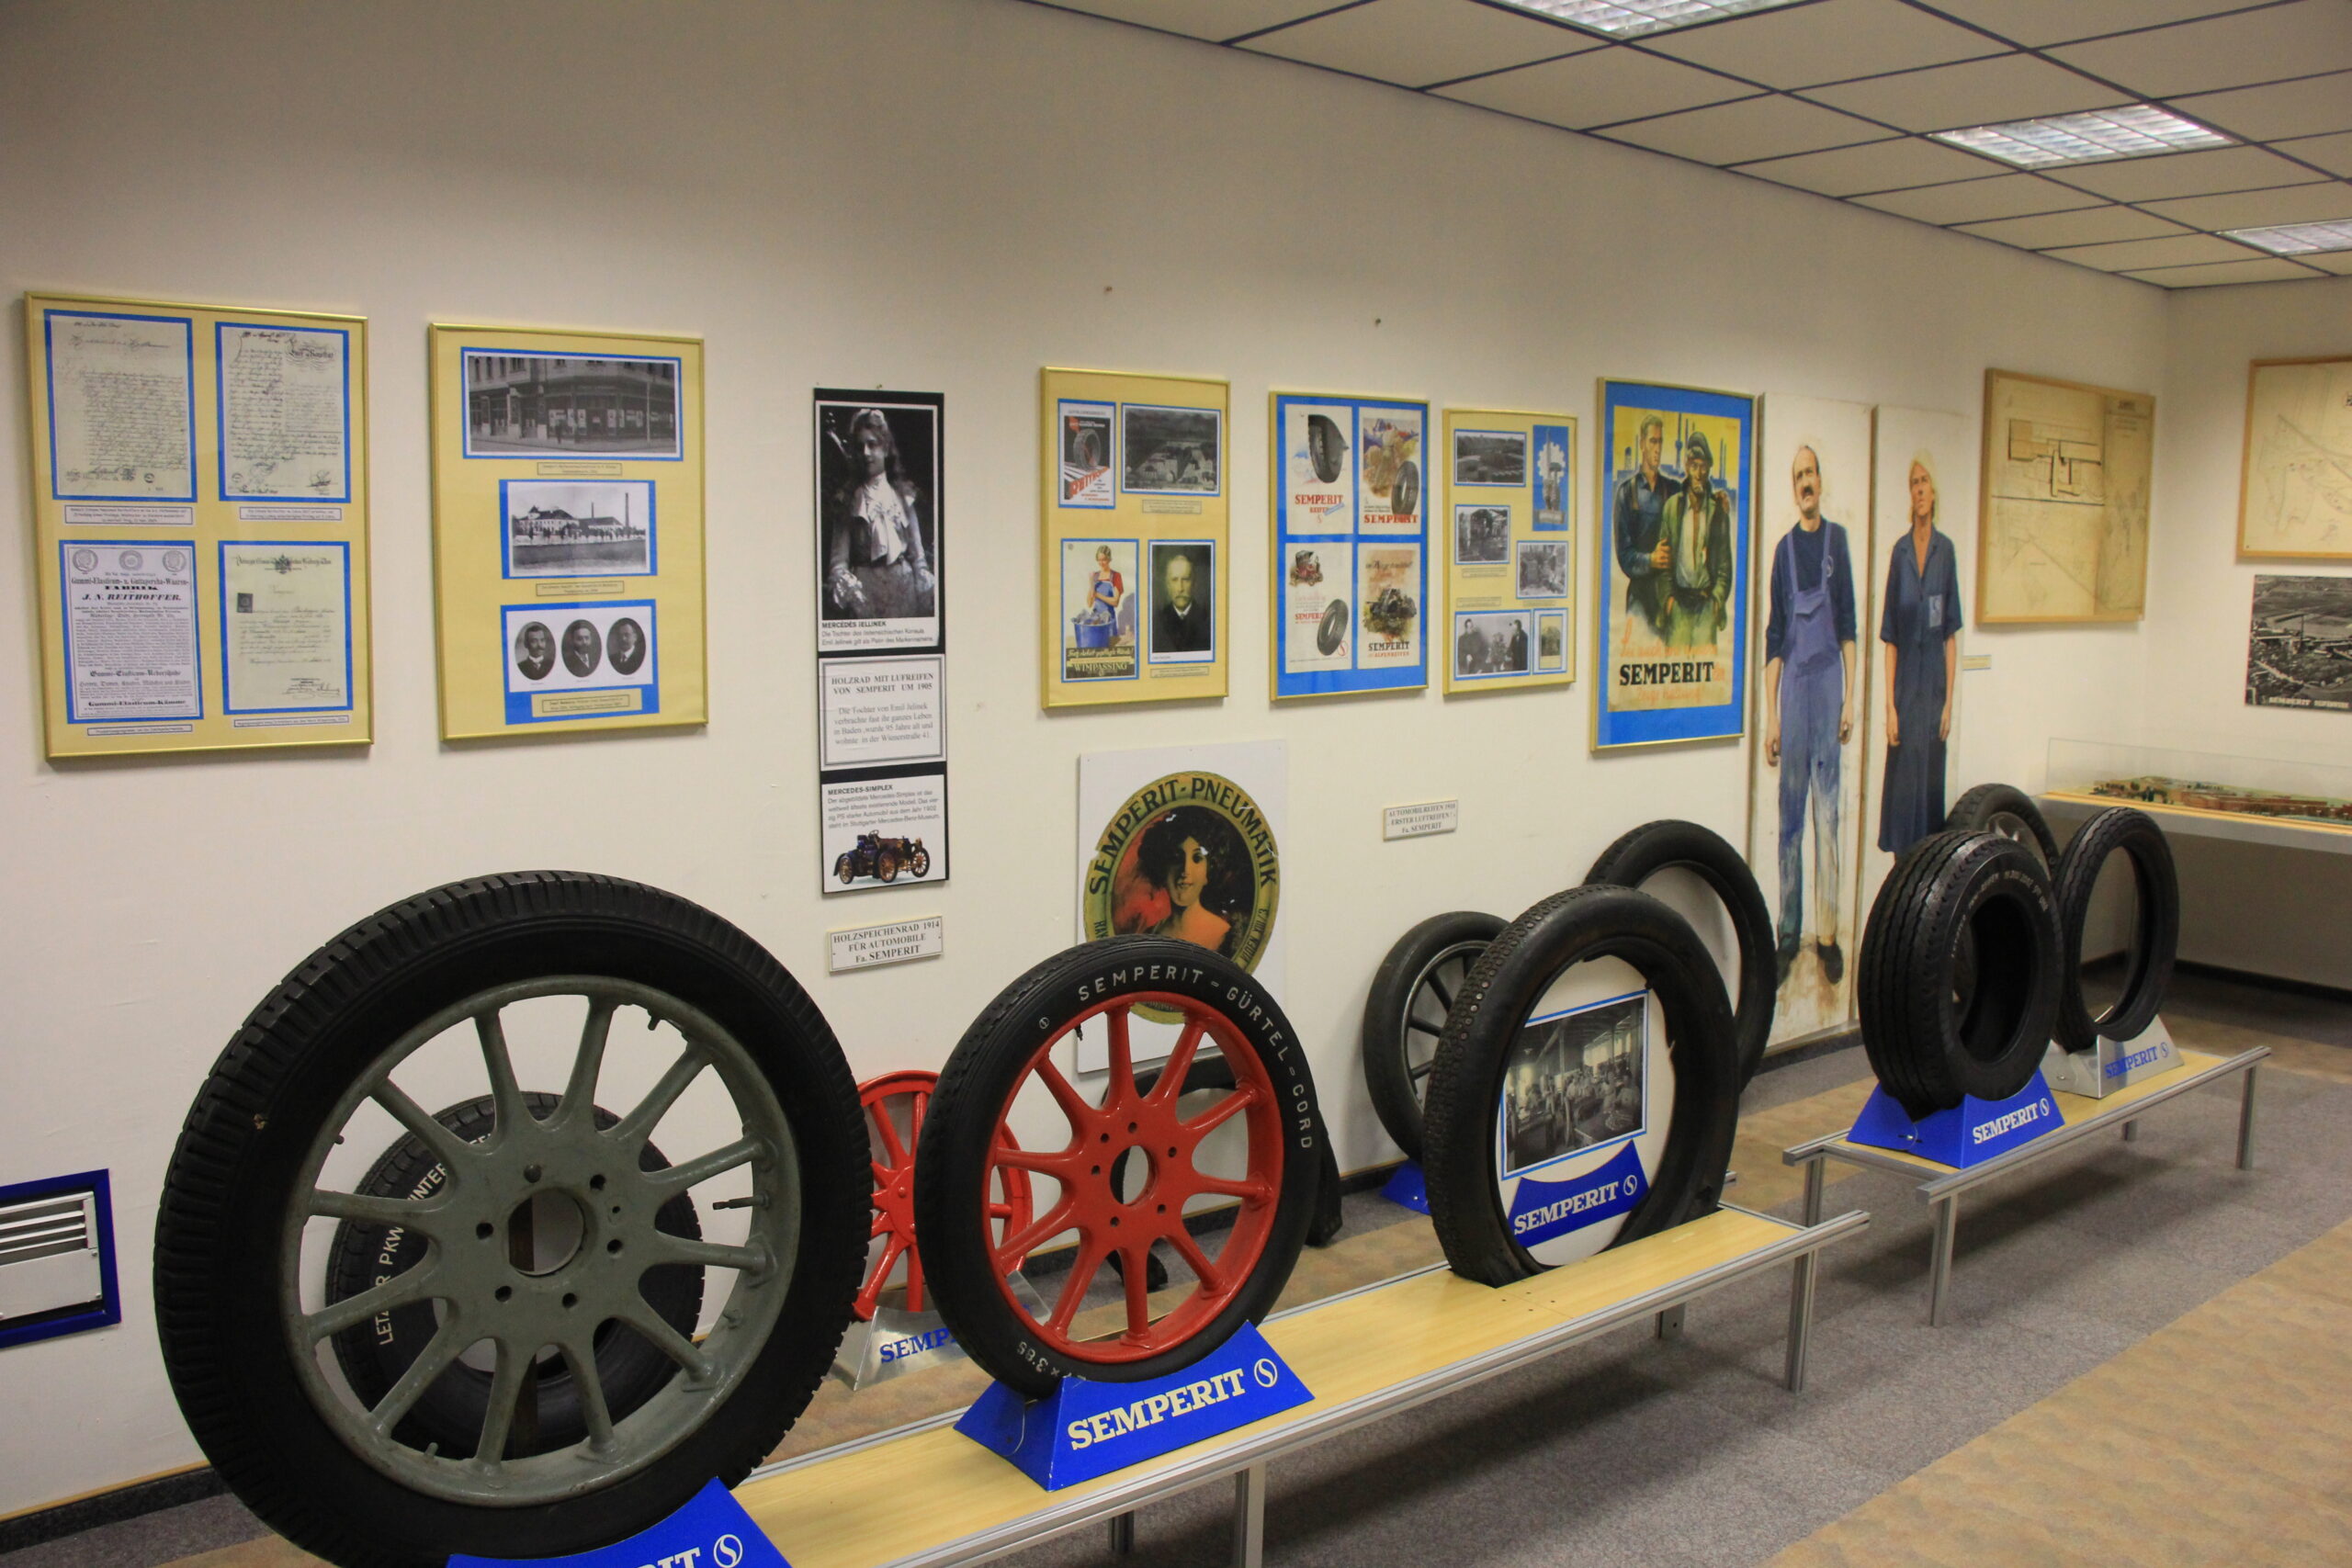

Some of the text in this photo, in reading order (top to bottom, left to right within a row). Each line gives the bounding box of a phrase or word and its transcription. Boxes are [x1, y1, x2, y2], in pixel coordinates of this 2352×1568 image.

[1295, 494, 1343, 504] SEMPERIT
[1363, 514, 1419, 523] SEMPERIT
[1368, 641, 1409, 651] SEMPERIT
[831, 676, 871, 684] HOLZRAD
[1620, 661, 1714, 685] SEMPERIT
[856, 684, 895, 694] SEMPERIT
[833, 920, 940, 943] HOLZSPEICHENRAD 1914
[849, 933, 926, 952] FÜR AUTOMOBILE
[869, 944, 921, 961] SEMPERIT
[2104, 1045, 2158, 1078] SEMPERIT
[1973, 1102, 2039, 1145] SEMPERIT
[1514, 1181, 1619, 1235] SEMPERIT
[880, 1327, 956, 1364] SEMP
[1068, 1368, 1246, 1450] SEMPERIT
